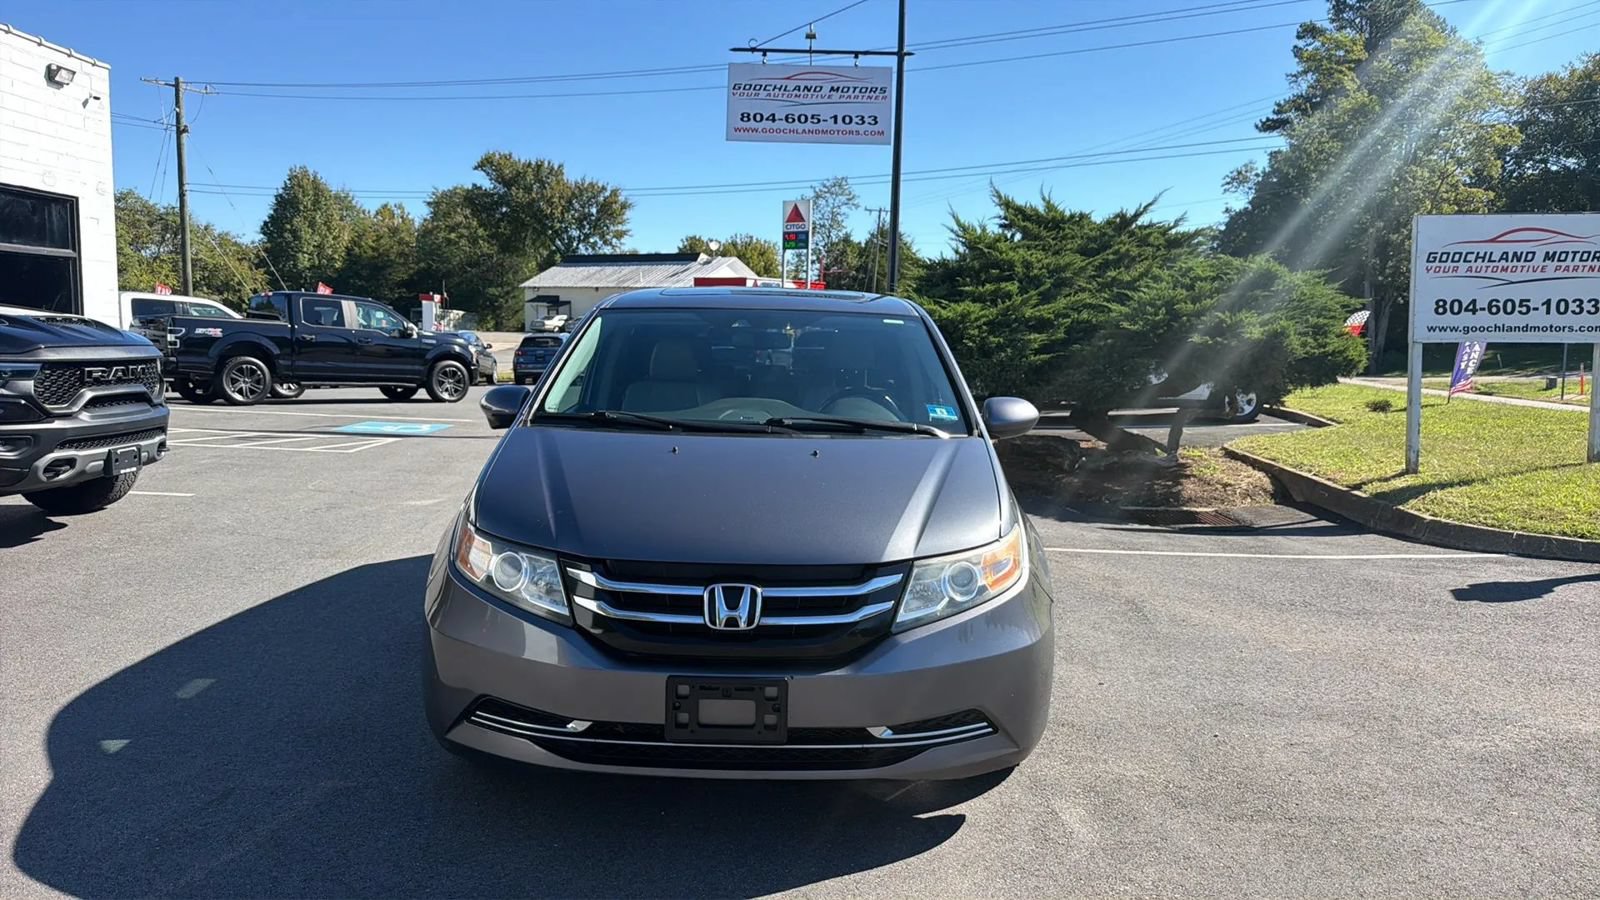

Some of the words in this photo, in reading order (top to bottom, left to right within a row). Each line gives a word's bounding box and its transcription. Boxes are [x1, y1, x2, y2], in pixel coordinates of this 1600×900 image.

[732, 83, 823, 93] GOOCHLAND
[829, 85, 888, 94] MOTORS
[739, 112, 879, 126] 804-605-1033
[733, 127, 885, 137] WWW.GOOCHLANDMOTORS.COM
[1425, 251, 1536, 264] GOOCHLAND
[1425, 265, 1459, 274] YOUR
[1465, 264, 1548, 273] AUTOMOTIVE
[1433, 298, 1600, 316] 804-605-1033
[84, 364, 146, 382] RAM
